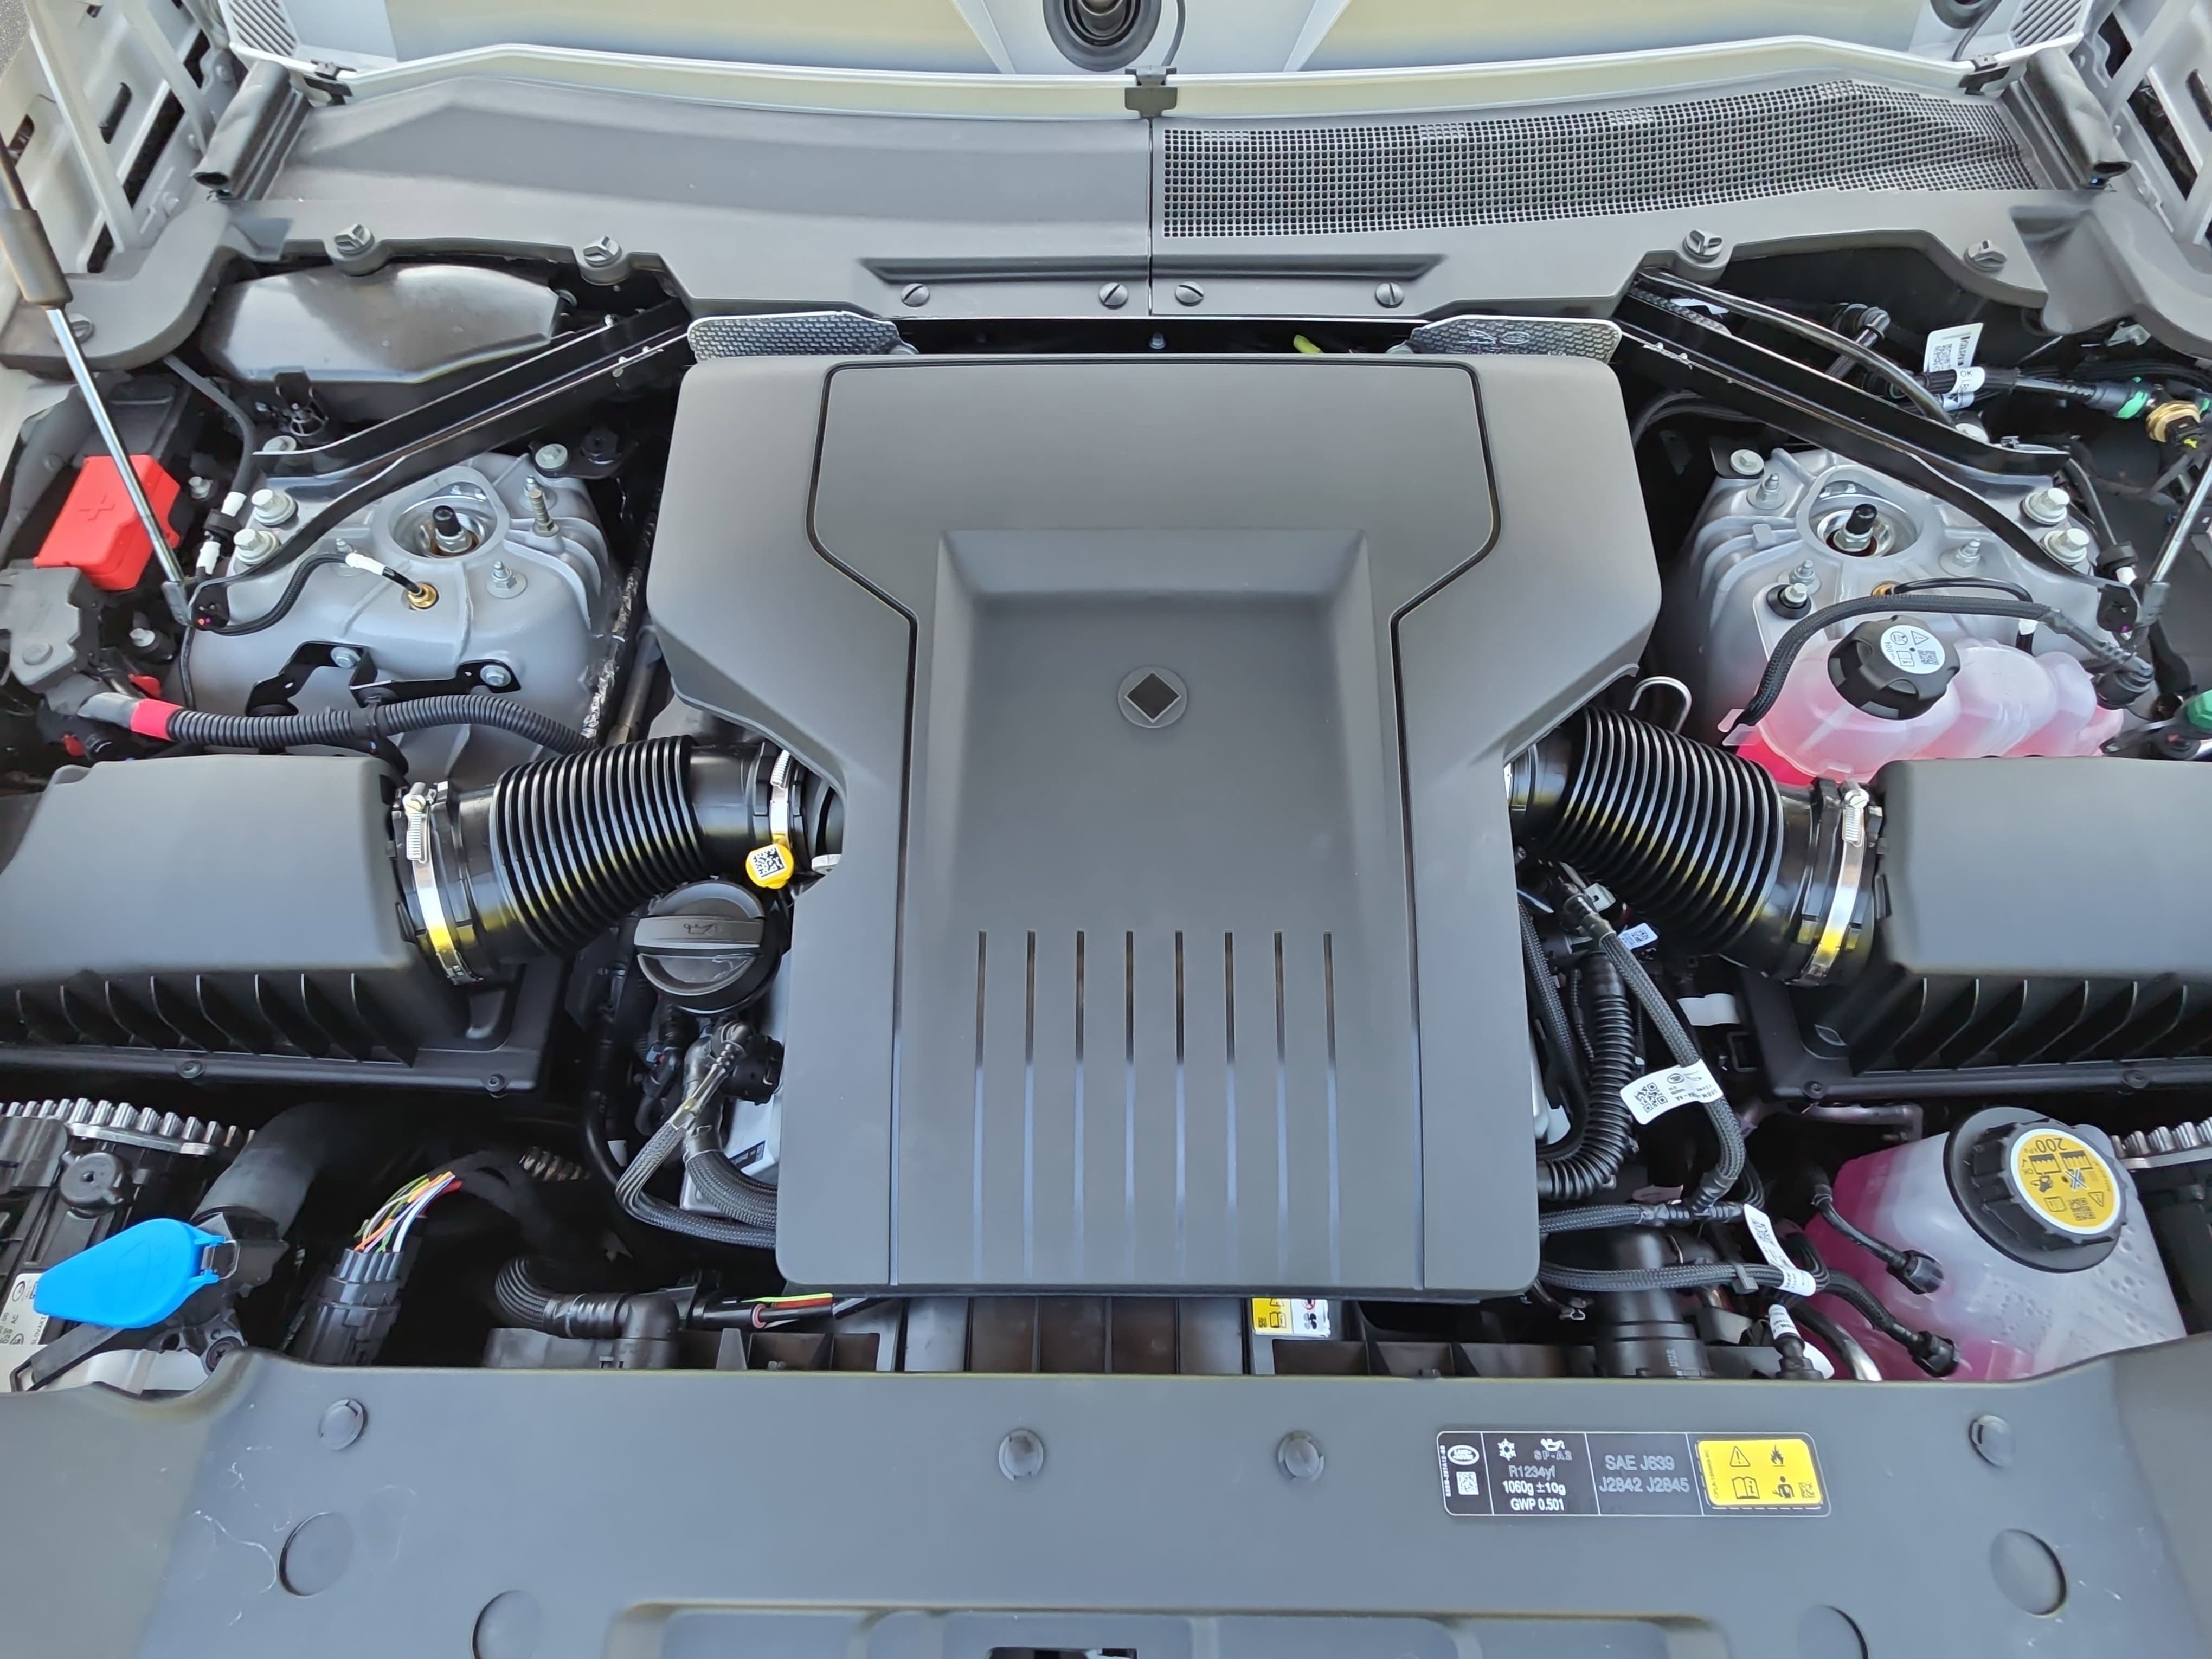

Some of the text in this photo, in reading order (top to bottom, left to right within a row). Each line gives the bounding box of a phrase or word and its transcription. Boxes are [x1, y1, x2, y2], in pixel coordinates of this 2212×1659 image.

[1884, 642, 1894, 653] 100
[2035, 1137, 2067, 1153] 200
[1534, 1450, 1572, 1461] SP-A2
[1605, 1455, 1675, 1471] SAE J639
[1502, 1480, 1566, 1496] 1060g ±10g
[1599, 1476, 1690, 1493] J2842 J2845
[1510, 1497, 1565, 1511] GWP 0.501
